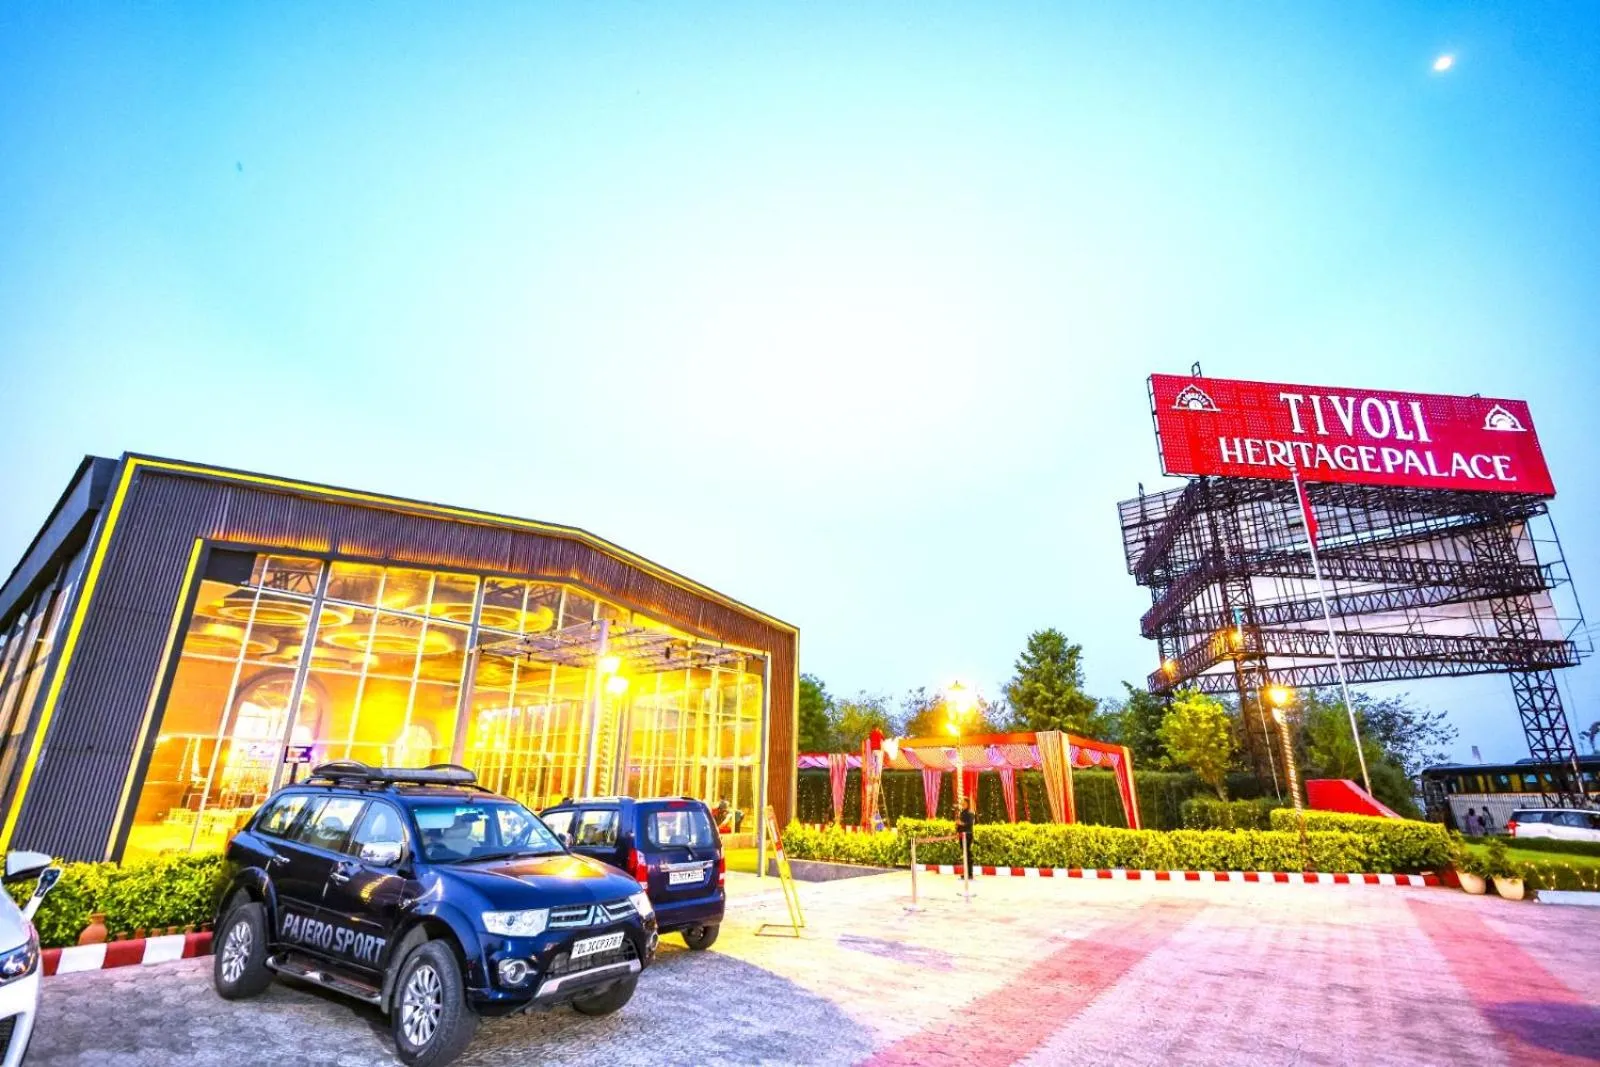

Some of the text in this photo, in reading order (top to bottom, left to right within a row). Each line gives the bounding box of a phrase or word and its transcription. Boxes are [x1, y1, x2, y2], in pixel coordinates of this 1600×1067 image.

[1280, 392, 1433, 443] TIVOLI
[281, 912, 387, 964] PAJERO SPORT
